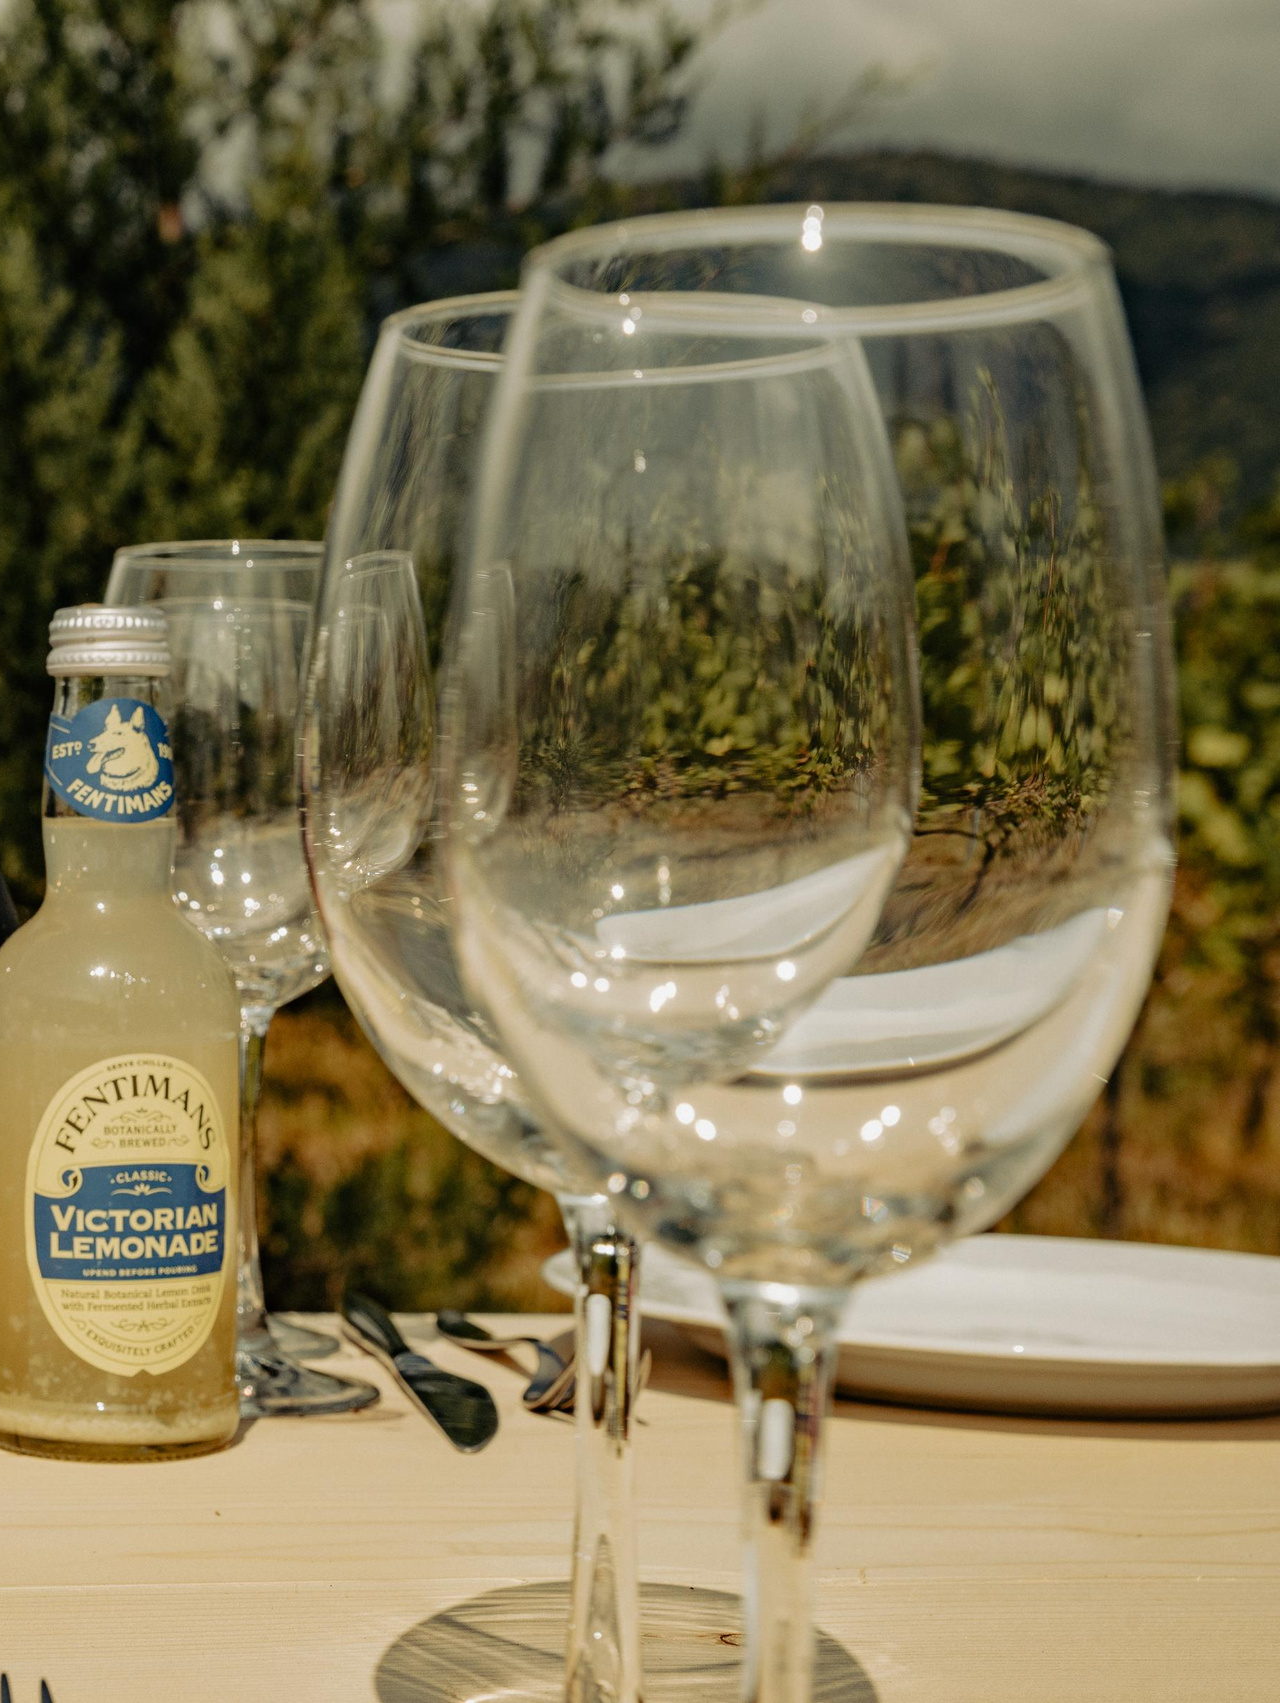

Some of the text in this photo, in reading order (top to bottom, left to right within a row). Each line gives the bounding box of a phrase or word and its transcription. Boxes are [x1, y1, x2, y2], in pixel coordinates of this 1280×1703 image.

[66, 778, 173, 815] FENTIMANS
[136, 1058, 174, 1070] CHILLED
[54, 1074, 216, 1155] FENTIMANS
[103, 1123, 178, 1136] BOTANICALLY
[119, 1138, 167, 1149] BREWED
[116, 1169, 168, 1184] CLASSIC
[50, 1202, 218, 1233] VICTORIAN
[49, 1229, 220, 1260] LEMONADE
[82, 1264, 198, 1278] UPEND BEFORE POURING
[61, 1289, 100, 1299] Natural
[104, 1288, 153, 1300] Botanical
[156, 1287, 189, 1297] Lemon
[62, 1301, 84, 1311] with
[87, 1301, 144, 1312] Fermented
[85, 1325, 195, 1356] EXQUISITELY CRAFTED
